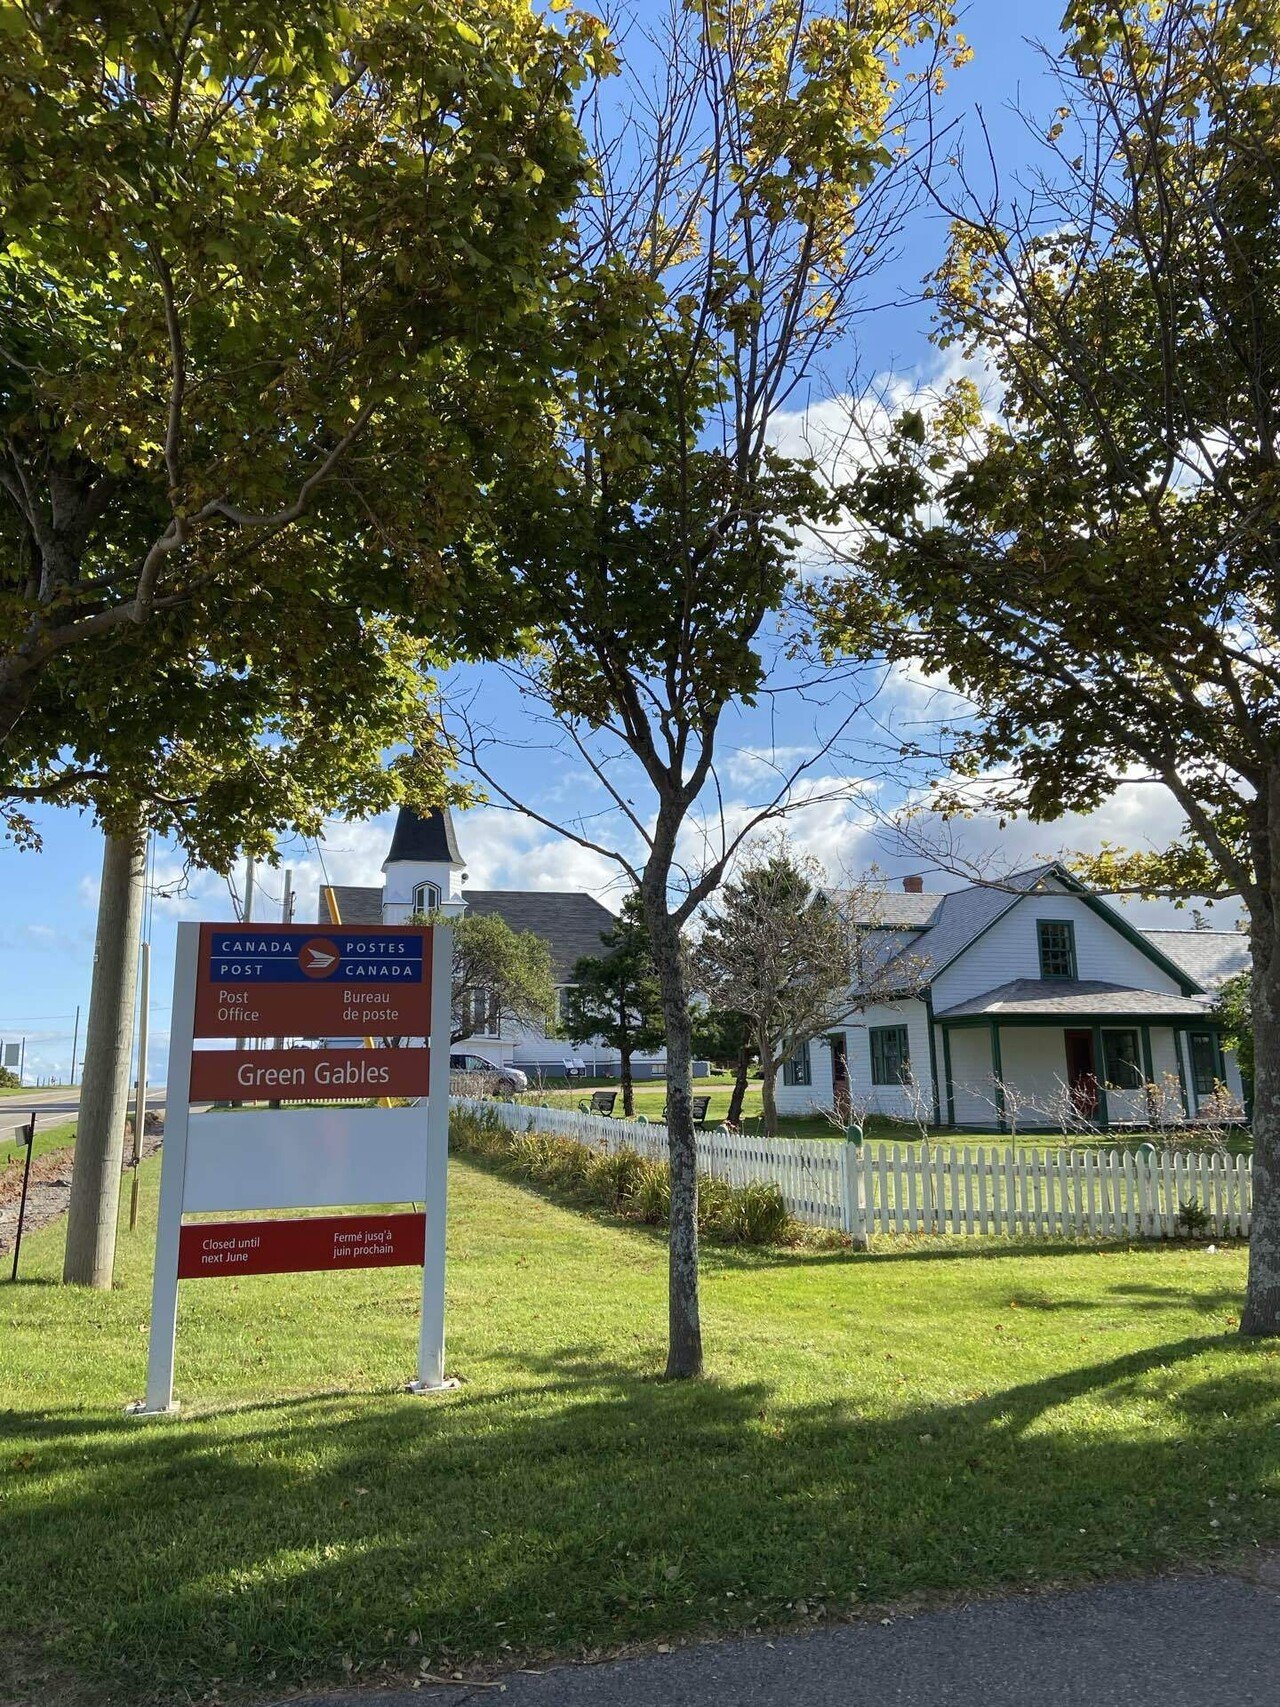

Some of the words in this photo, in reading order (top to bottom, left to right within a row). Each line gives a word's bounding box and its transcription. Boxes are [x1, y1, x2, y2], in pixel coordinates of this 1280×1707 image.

[222, 941, 293, 952] CANADA
[346, 942, 405, 953] POSTES
[220, 965, 263, 975] POST
[345, 965, 413, 976] CANADA
[219, 990, 249, 1004] Post
[343, 990, 390, 1003] Bureau
[218, 1008, 260, 1022] Office
[342, 1007, 359, 1020] de
[362, 1009, 399, 1023] poste
[237, 1063, 305, 1086] Green
[314, 1060, 389, 1085] Gables
[202, 1239, 236, 1250] Closed
[238, 1237, 260, 1249] until
[333, 1231, 363, 1243] Fermé
[364, 1230, 392, 1244] jusq'à
[201, 1253, 223, 1264] next
[225, 1251, 249, 1263] June
[333, 1245, 351, 1259] juin
[353, 1243, 394, 1257] prochain
